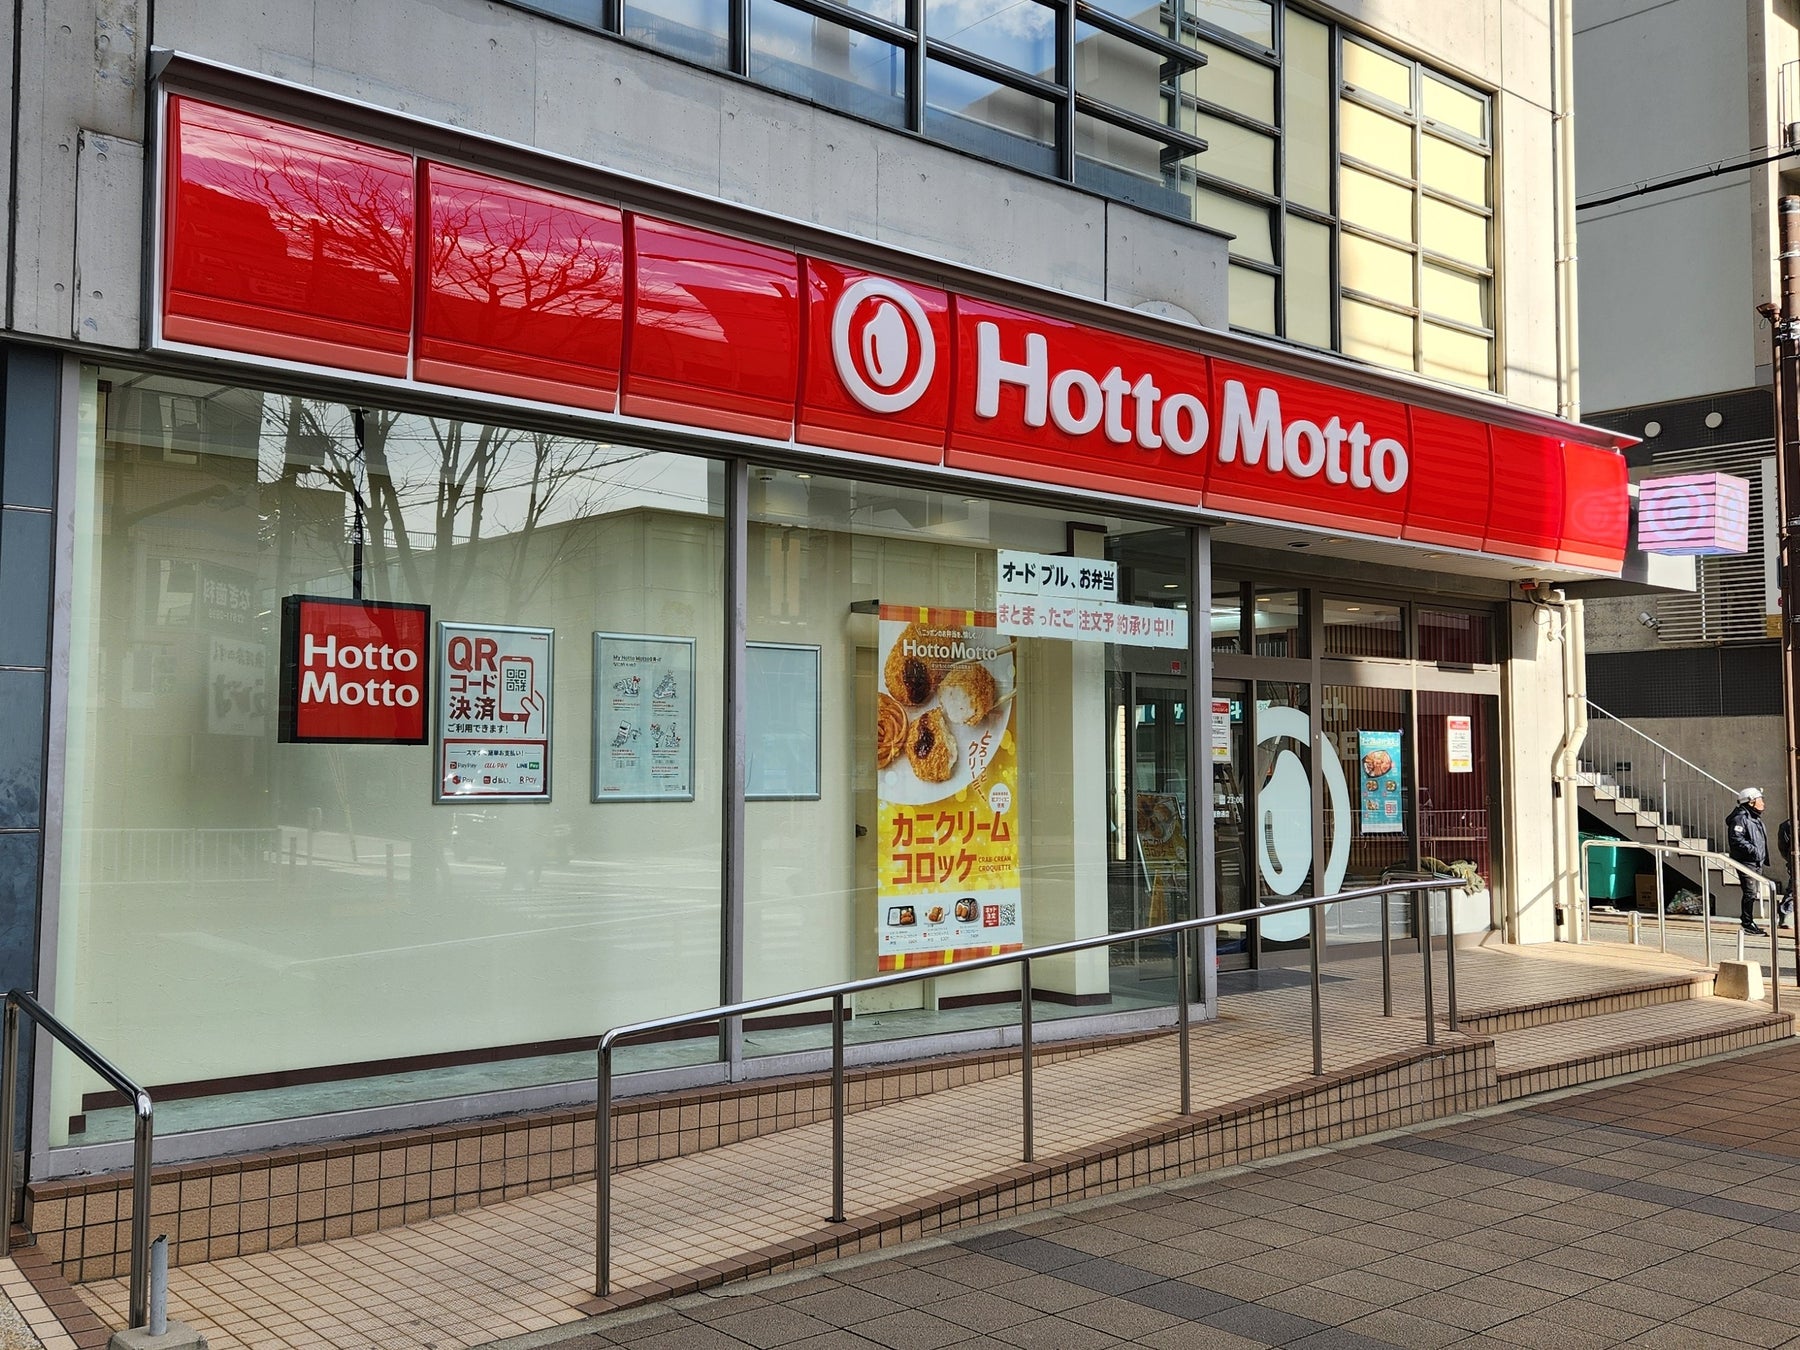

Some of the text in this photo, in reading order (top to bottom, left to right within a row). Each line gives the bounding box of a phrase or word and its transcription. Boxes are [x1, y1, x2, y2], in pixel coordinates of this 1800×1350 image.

[975, 321, 1409, 493] Hotto Motto
[1002, 561, 1115, 591] オードブル、お弁当
[999, 603, 1174, 637] まとまったご注文予約承り中!!
[304, 633, 417, 671] Hotto
[447, 636, 498, 672] QR
[300, 671, 419, 707] Motto
[449, 673, 498, 694] コード
[449, 696, 496, 721] 決済
[892, 811, 1011, 848] カニクリーム
[892, 848, 977, 885] コロッケ
